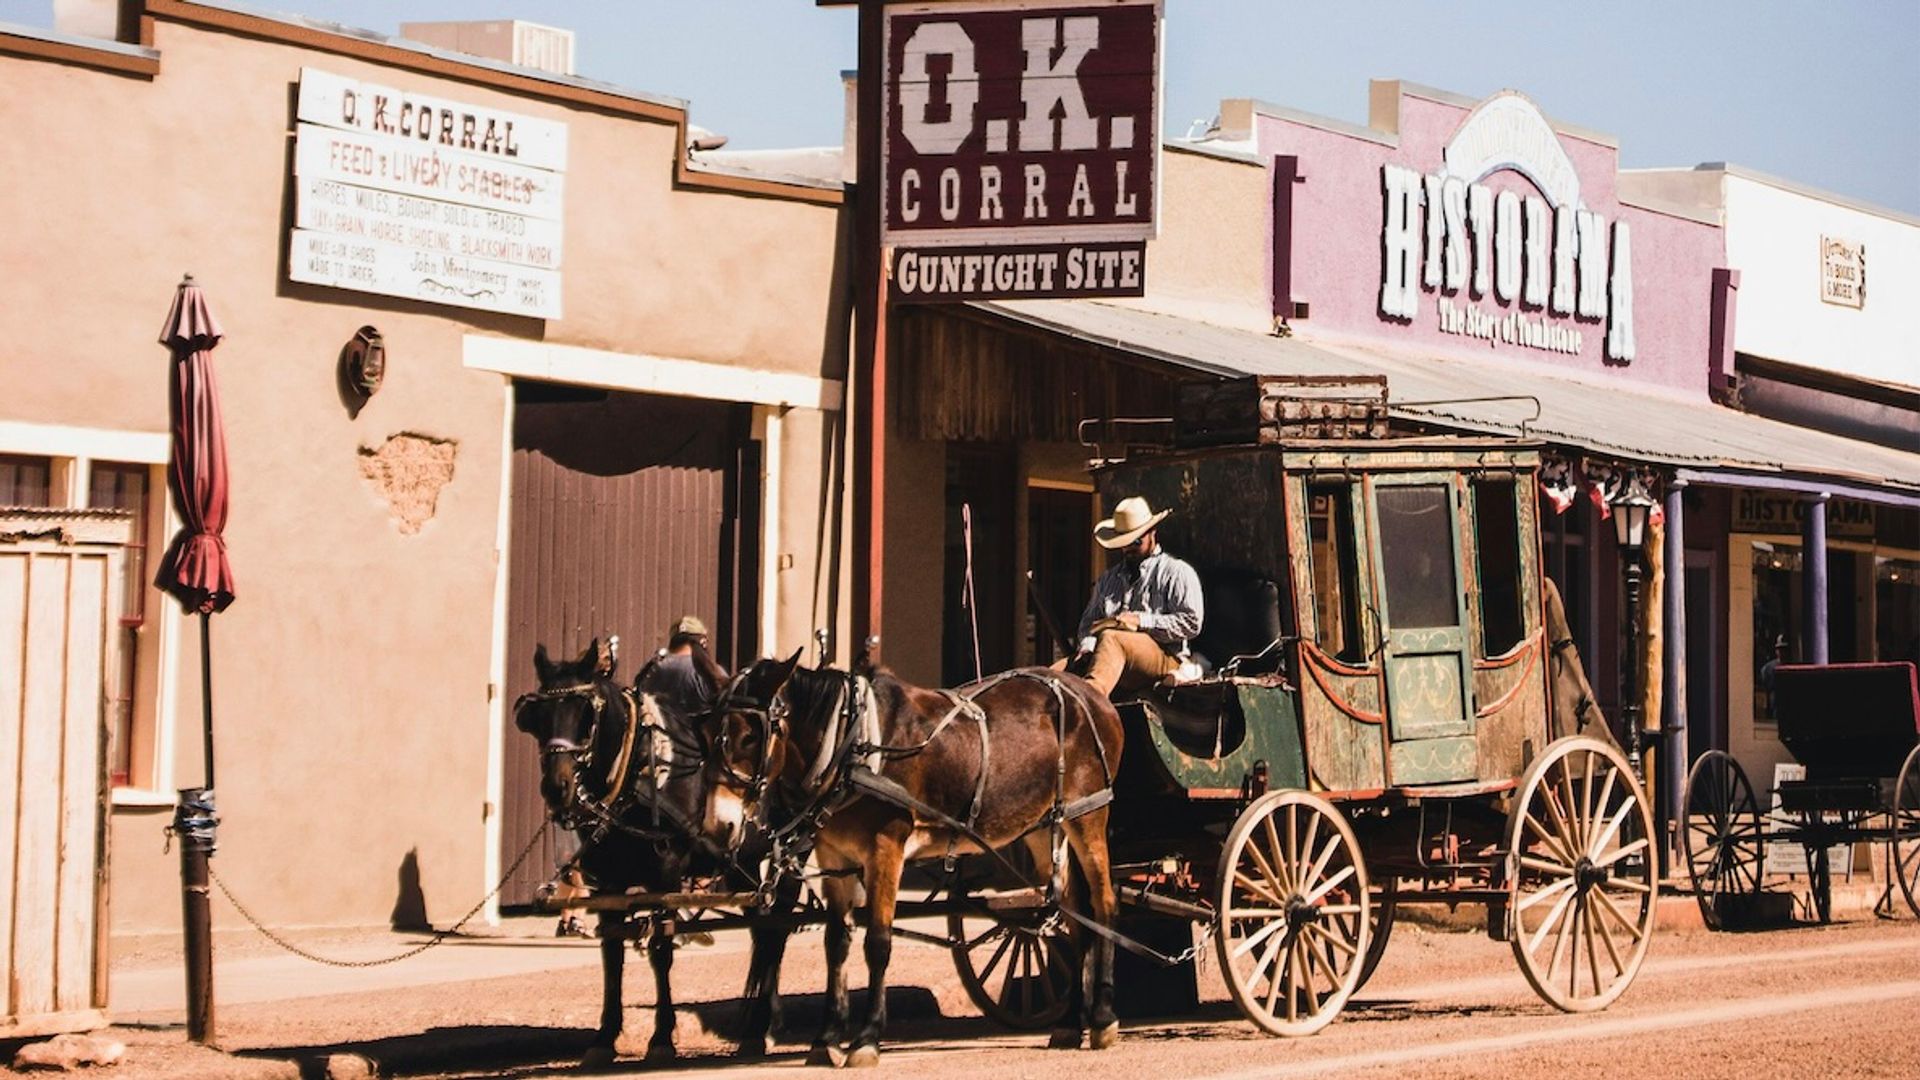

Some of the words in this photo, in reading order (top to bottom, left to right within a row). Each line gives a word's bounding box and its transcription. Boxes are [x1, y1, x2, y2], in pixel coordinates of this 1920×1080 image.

[899, 16, 1134, 155] O.K.
[400, 101, 518, 157] CORRAL
[330, 141, 373, 176] FEED
[393, 150, 452, 190] LIVERY
[458, 164, 533, 205] STABLES
[901, 161, 1137, 223] CORRAL
[371, 219, 404, 244] HORSE
[460, 234, 522, 261] BLACKSMITH
[486, 212, 525, 238] TRADED
[410, 251, 437, 274] John
[1378, 163, 1636, 364] HISTORAMA
[1438, 297, 1465, 335] The
[1465, 302, 1501, 348] Story
[1502, 311, 1518, 345] of
[1515, 312, 1583, 356] Tombstone
[1739, 494, 1872, 524] HISTOAMA
